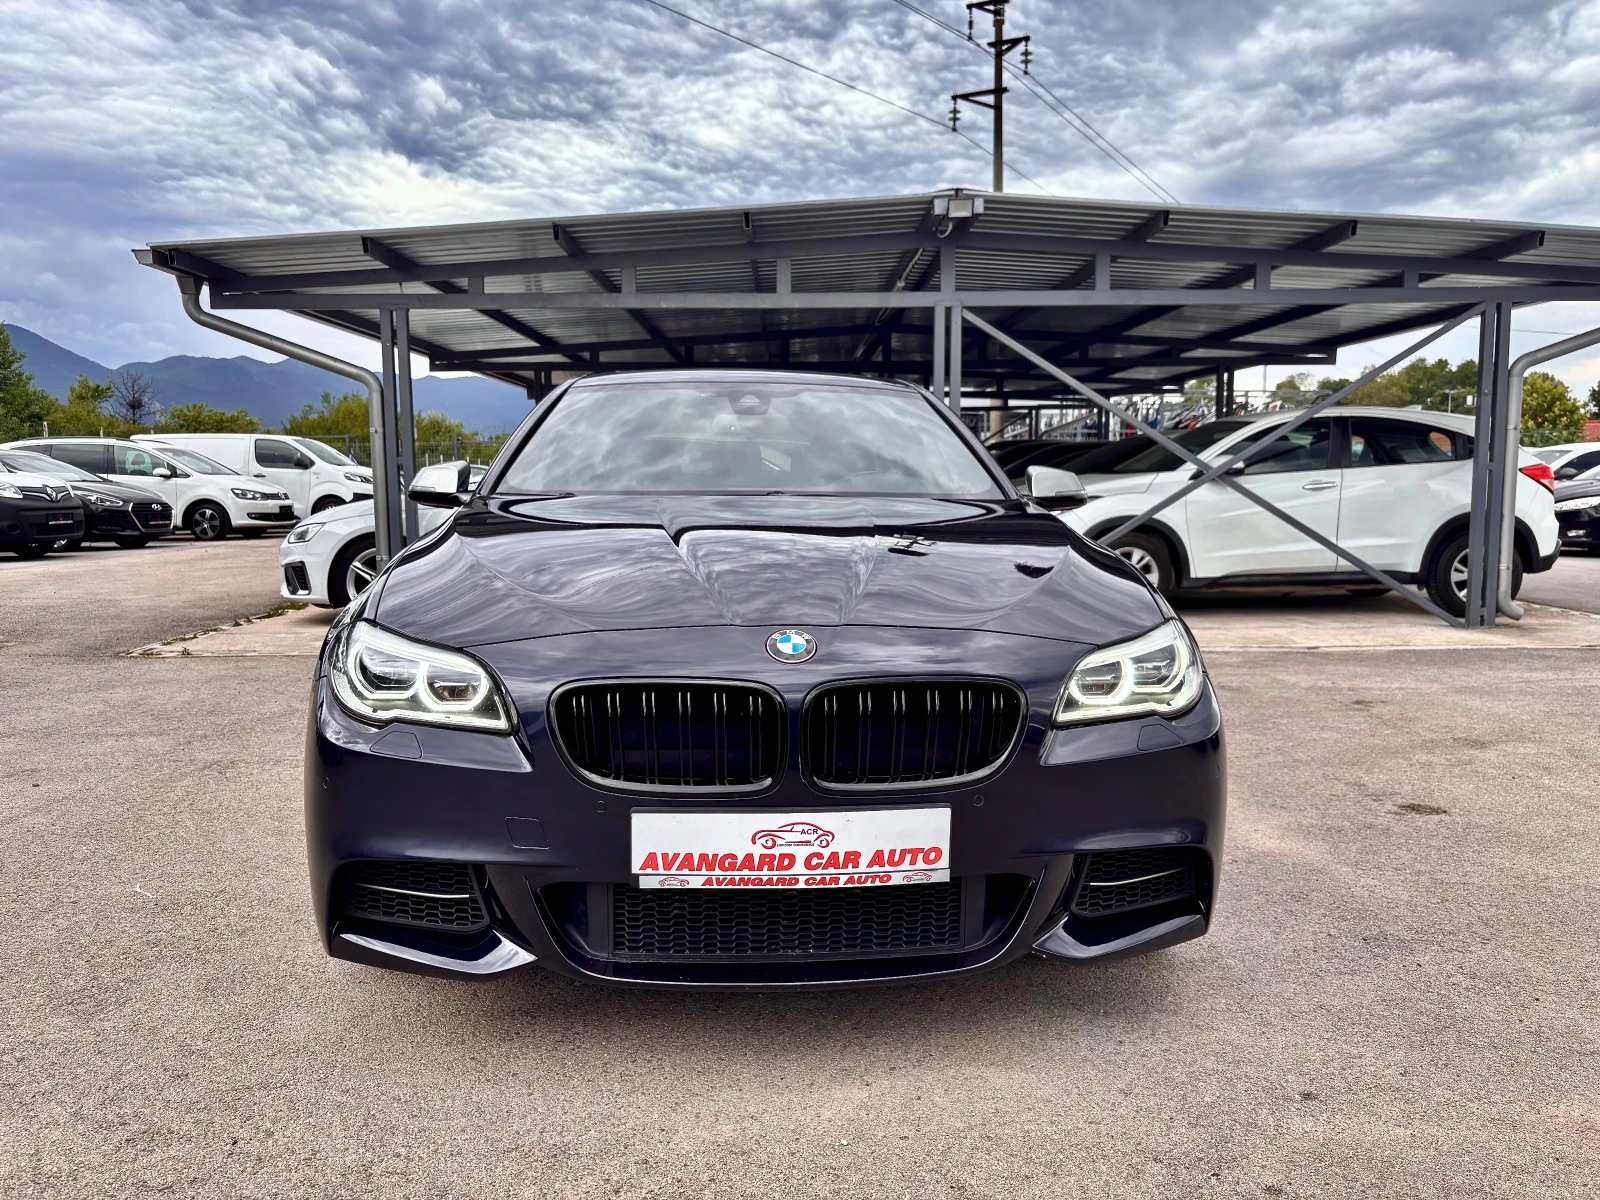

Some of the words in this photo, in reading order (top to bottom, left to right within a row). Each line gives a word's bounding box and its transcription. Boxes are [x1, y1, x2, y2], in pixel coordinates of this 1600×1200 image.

[639, 852, 796, 872] AVANGARD
[804, 851, 861, 871] CAR
[866, 847, 943, 868] AUTO
[701, 877, 799, 887] AVANGARD
[804, 876, 840, 886] CAR
[843, 874, 892, 885] AUTO
